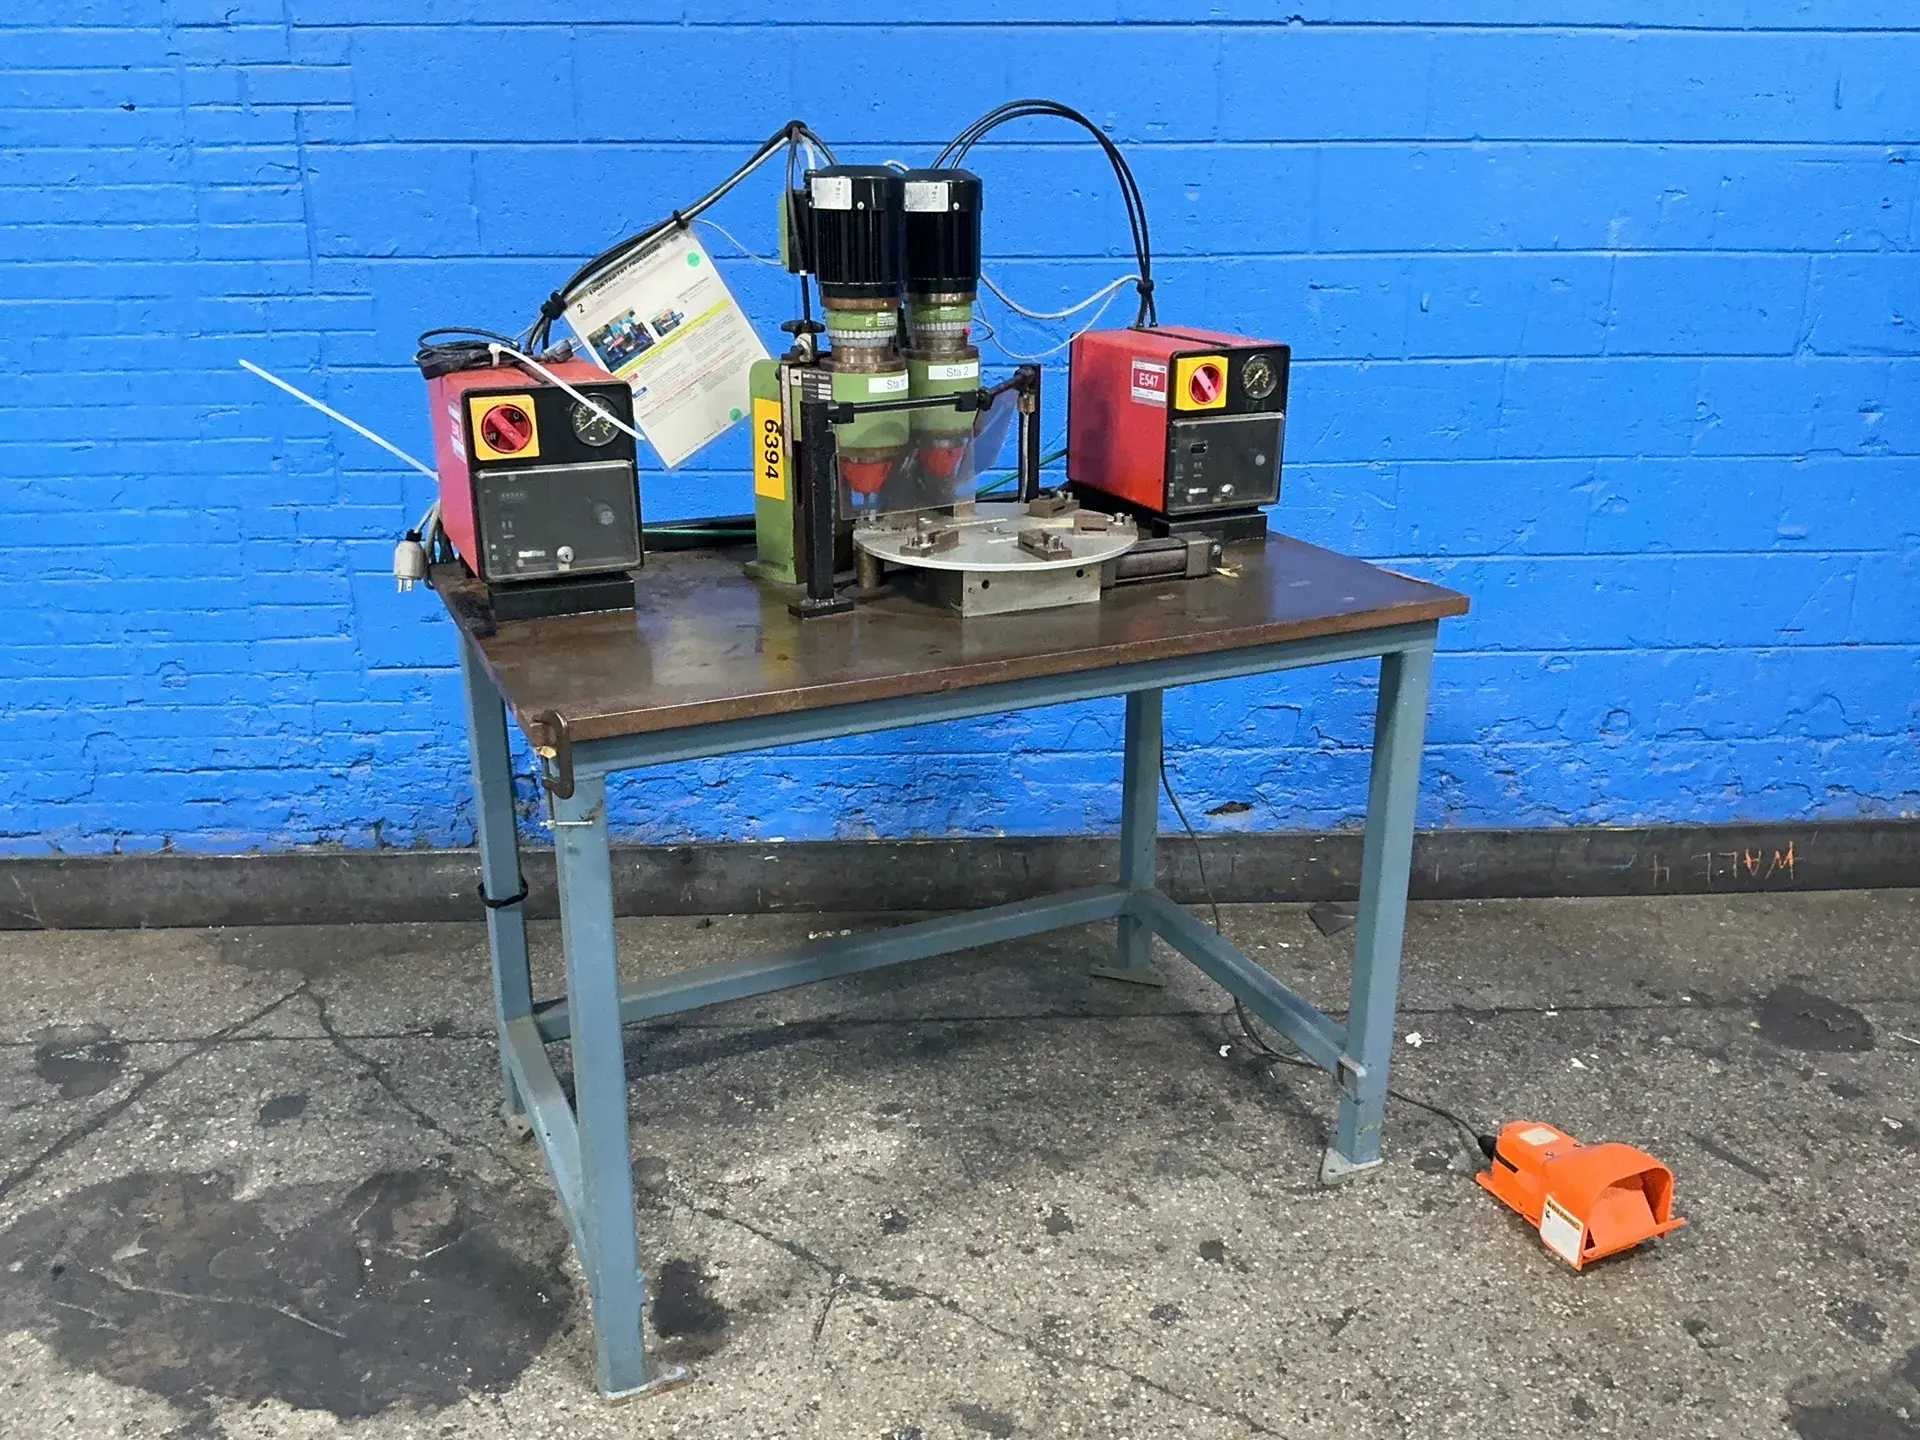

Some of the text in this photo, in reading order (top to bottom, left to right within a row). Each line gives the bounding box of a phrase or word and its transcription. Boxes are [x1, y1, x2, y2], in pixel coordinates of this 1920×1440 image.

[577, 303, 585, 314] 2
[946, 362, 969, 377] Sta 2
[886, 379, 900, 390] Sta
[1139, 373, 1159, 388] E547
[764, 419, 780, 479] 6394
[1649, 840, 1797, 886] WALL 4
